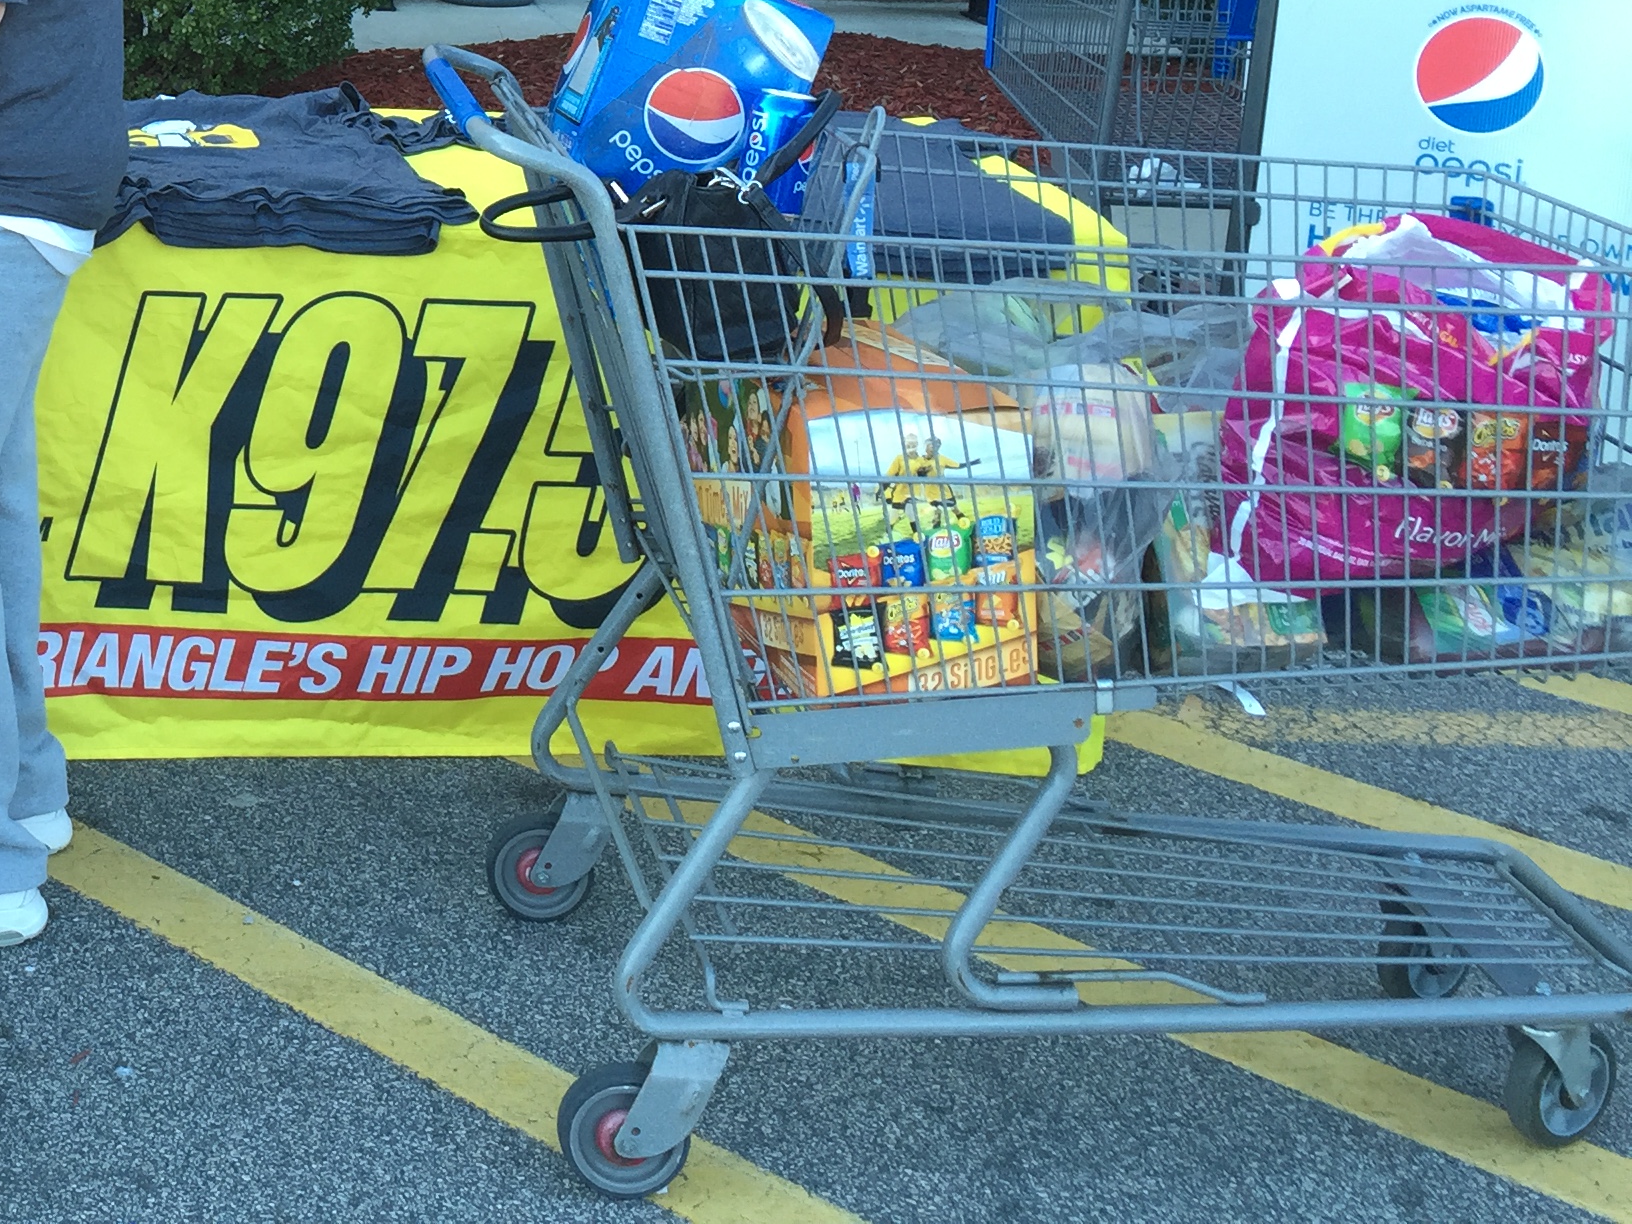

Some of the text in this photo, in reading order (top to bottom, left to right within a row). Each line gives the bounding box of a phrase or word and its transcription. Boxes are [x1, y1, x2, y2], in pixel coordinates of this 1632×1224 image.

[1436, 4, 1537, 31] NOW ASPARTAME FREE
[609, 129, 664, 180] pep
[1418, 136, 1456, 154] diet
[1309, 200, 1337, 220] BE
[1394, 516, 1475, 548] Flavor
[36, 630, 348, 694] RIANGLE'S
[357, 645, 473, 696] HIP
